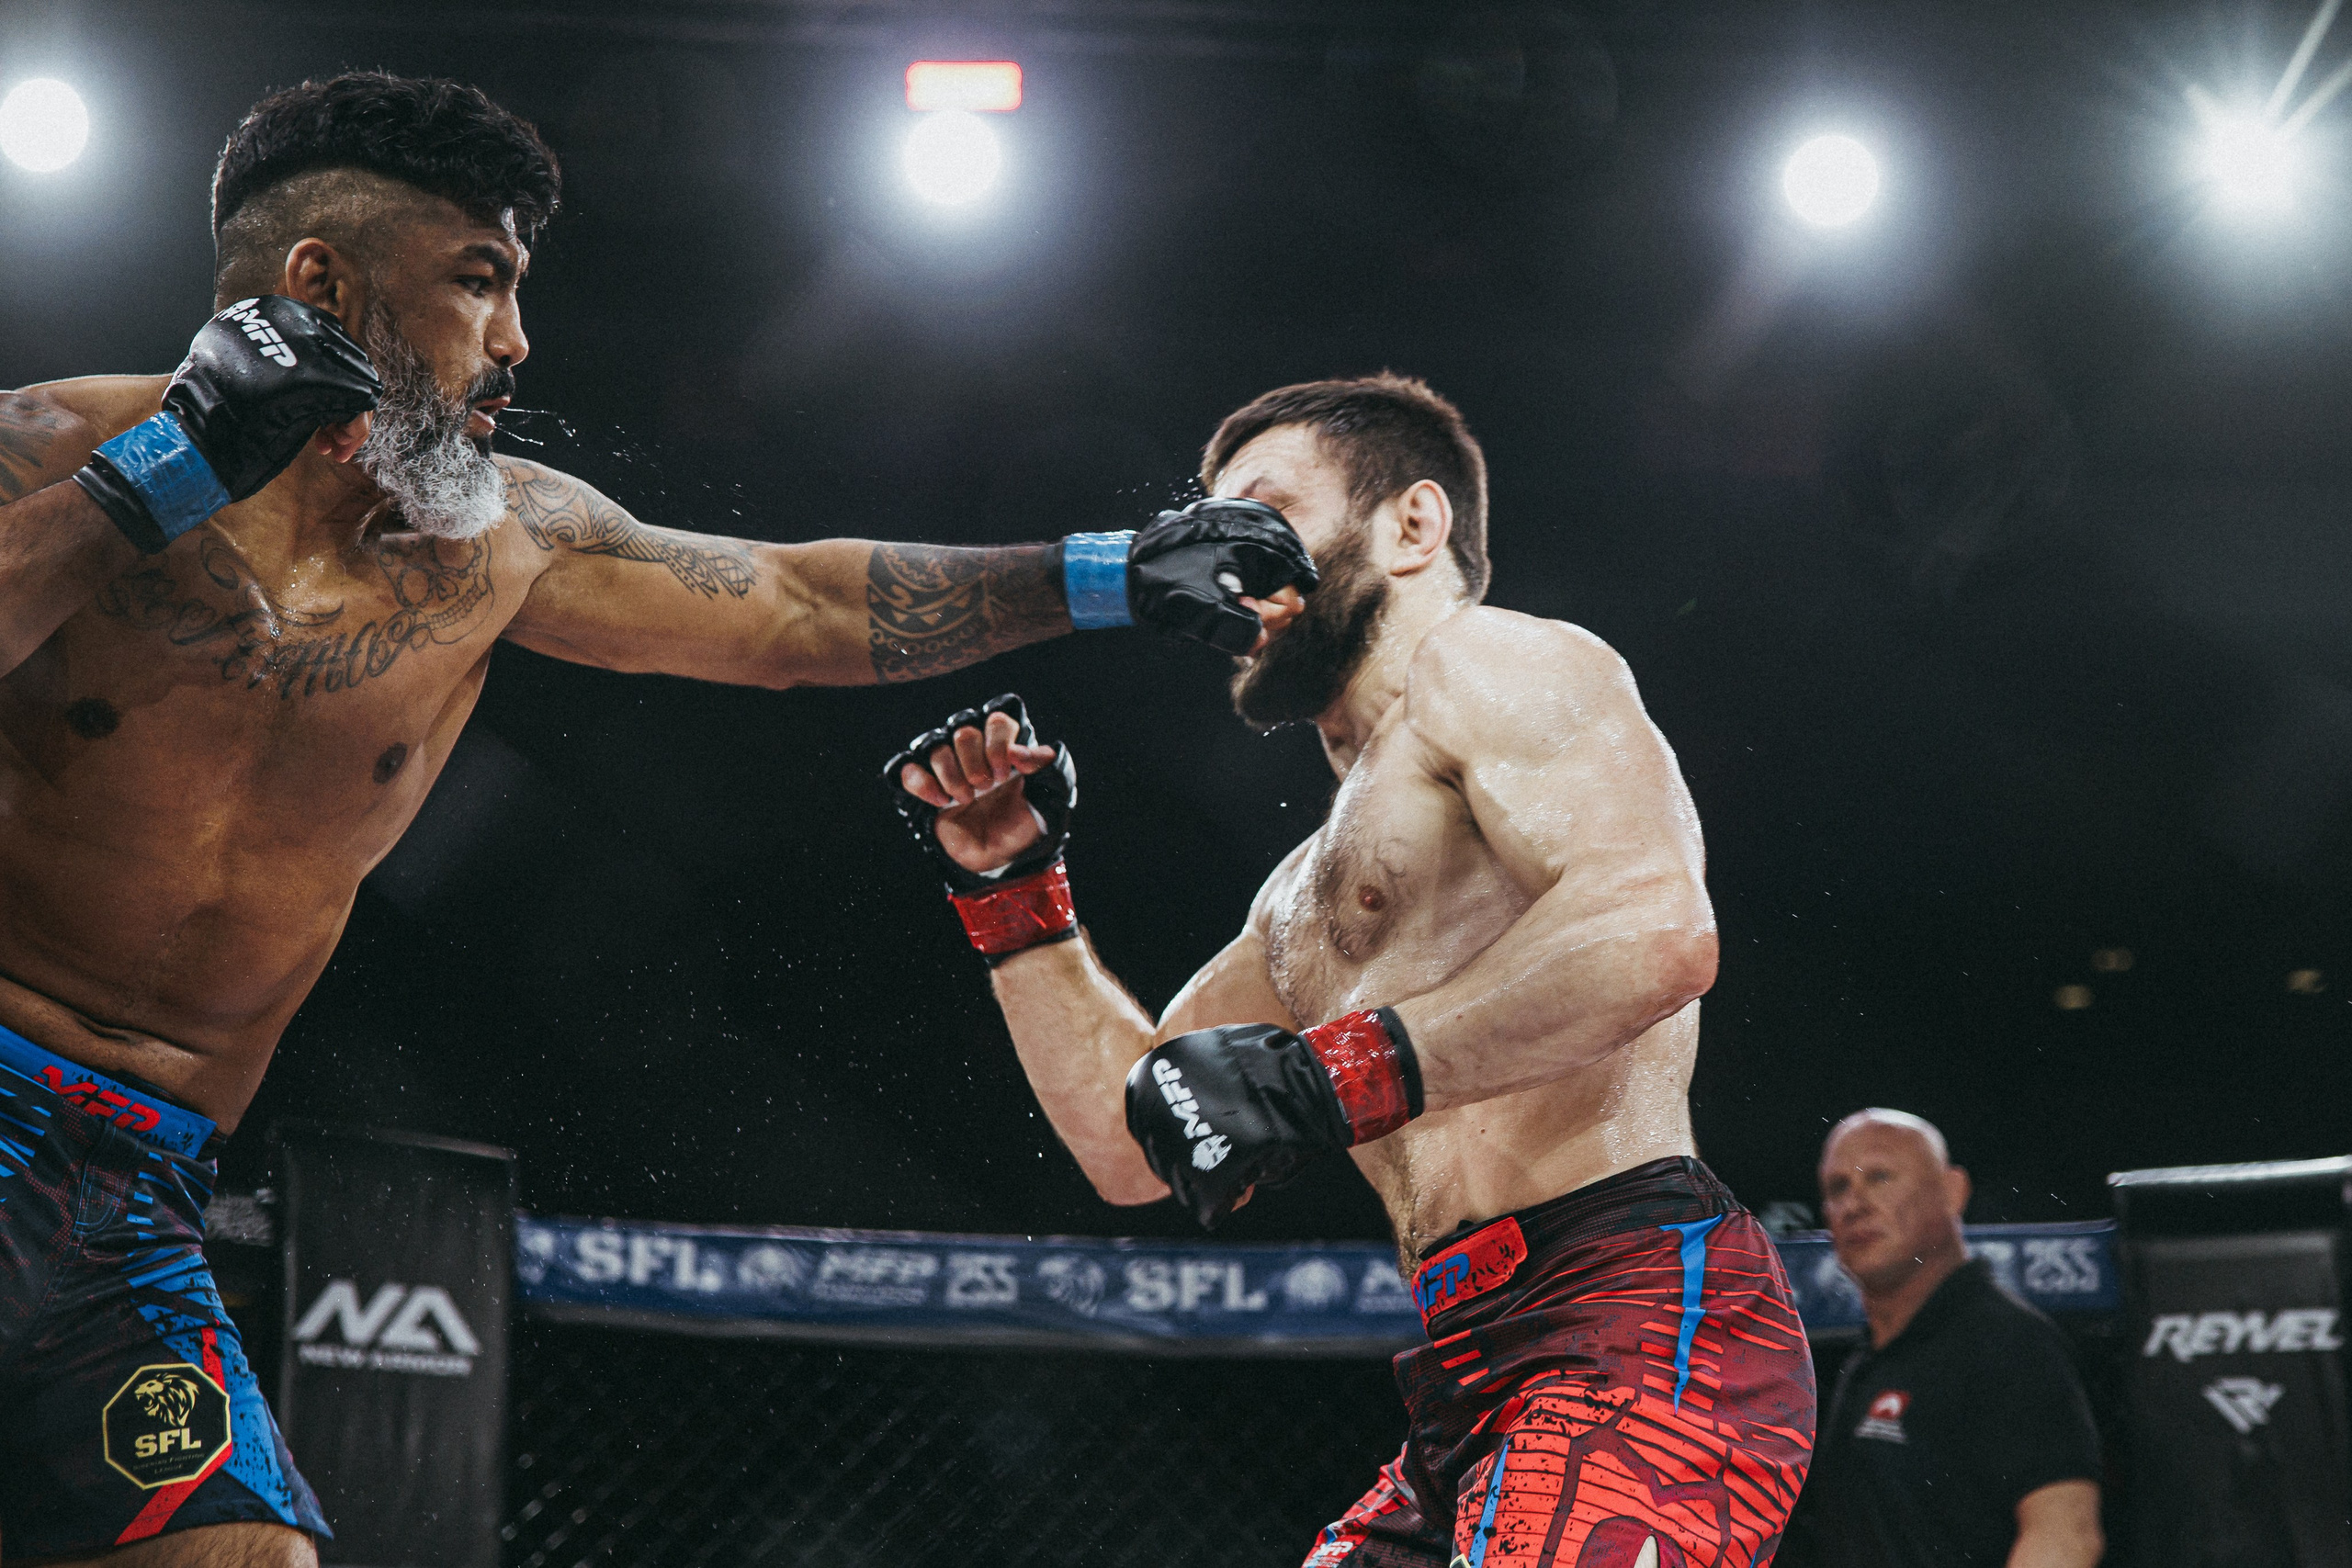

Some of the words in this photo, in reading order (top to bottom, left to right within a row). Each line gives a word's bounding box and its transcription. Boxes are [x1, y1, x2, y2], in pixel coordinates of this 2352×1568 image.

[232, 309, 298, 367] MFP
[1152, 1057, 1214, 1140] MFP
[574, 1229, 722, 1292] SFL
[1123, 1256, 1268, 1312] SFL
[135, 1427, 201, 1458] SFL
